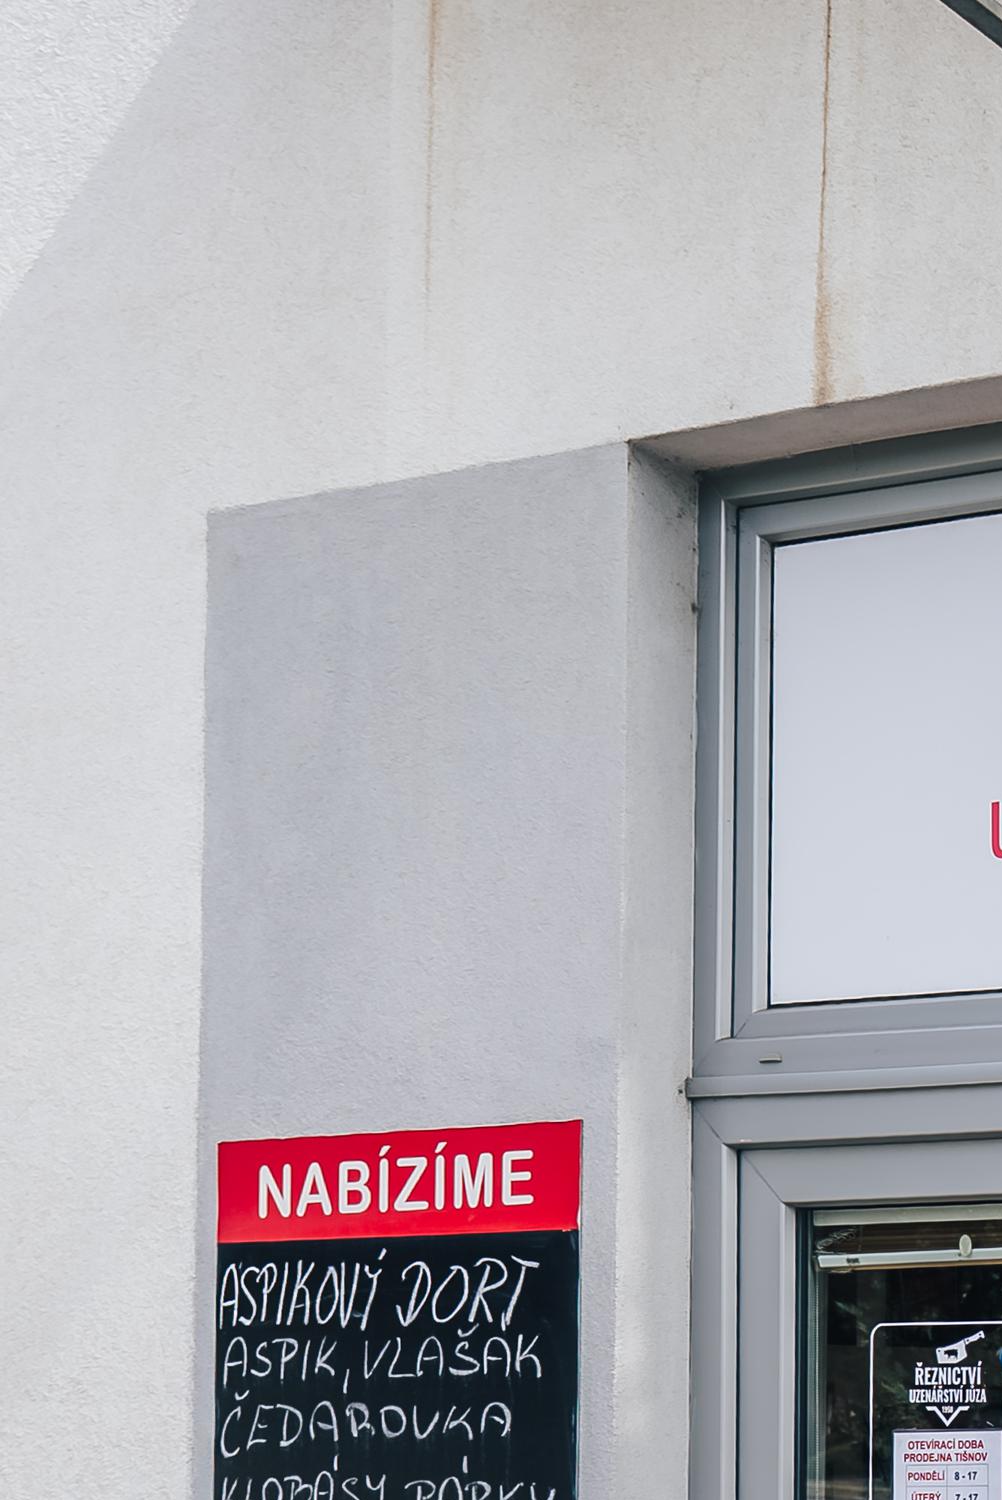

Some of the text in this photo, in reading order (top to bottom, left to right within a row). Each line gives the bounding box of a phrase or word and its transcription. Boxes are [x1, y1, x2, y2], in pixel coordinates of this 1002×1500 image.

[258, 1141, 535, 1219] NABÍZÍME
[219, 1248, 540, 1331] ASPIKOVÝ DORT
[223, 1323, 542, 1394] ASPIK, VLAŠAK
[914, 1360, 982, 1385] ŘEZNICTVÍ
[909, 1384, 987, 1403] UZENÁŘSTVÍ JŮZA
[220, 1389, 513, 1458] ČEDAROVKA
[904, 1451, 987, 1462] PRODEJNA TIŠNOV
[908, 1438, 984, 1450] OTEVÍRACÍ DOBA
[908, 1470, 945, 1480] PONDĚLÍ
[967, 1471, 977, 1480] 17
